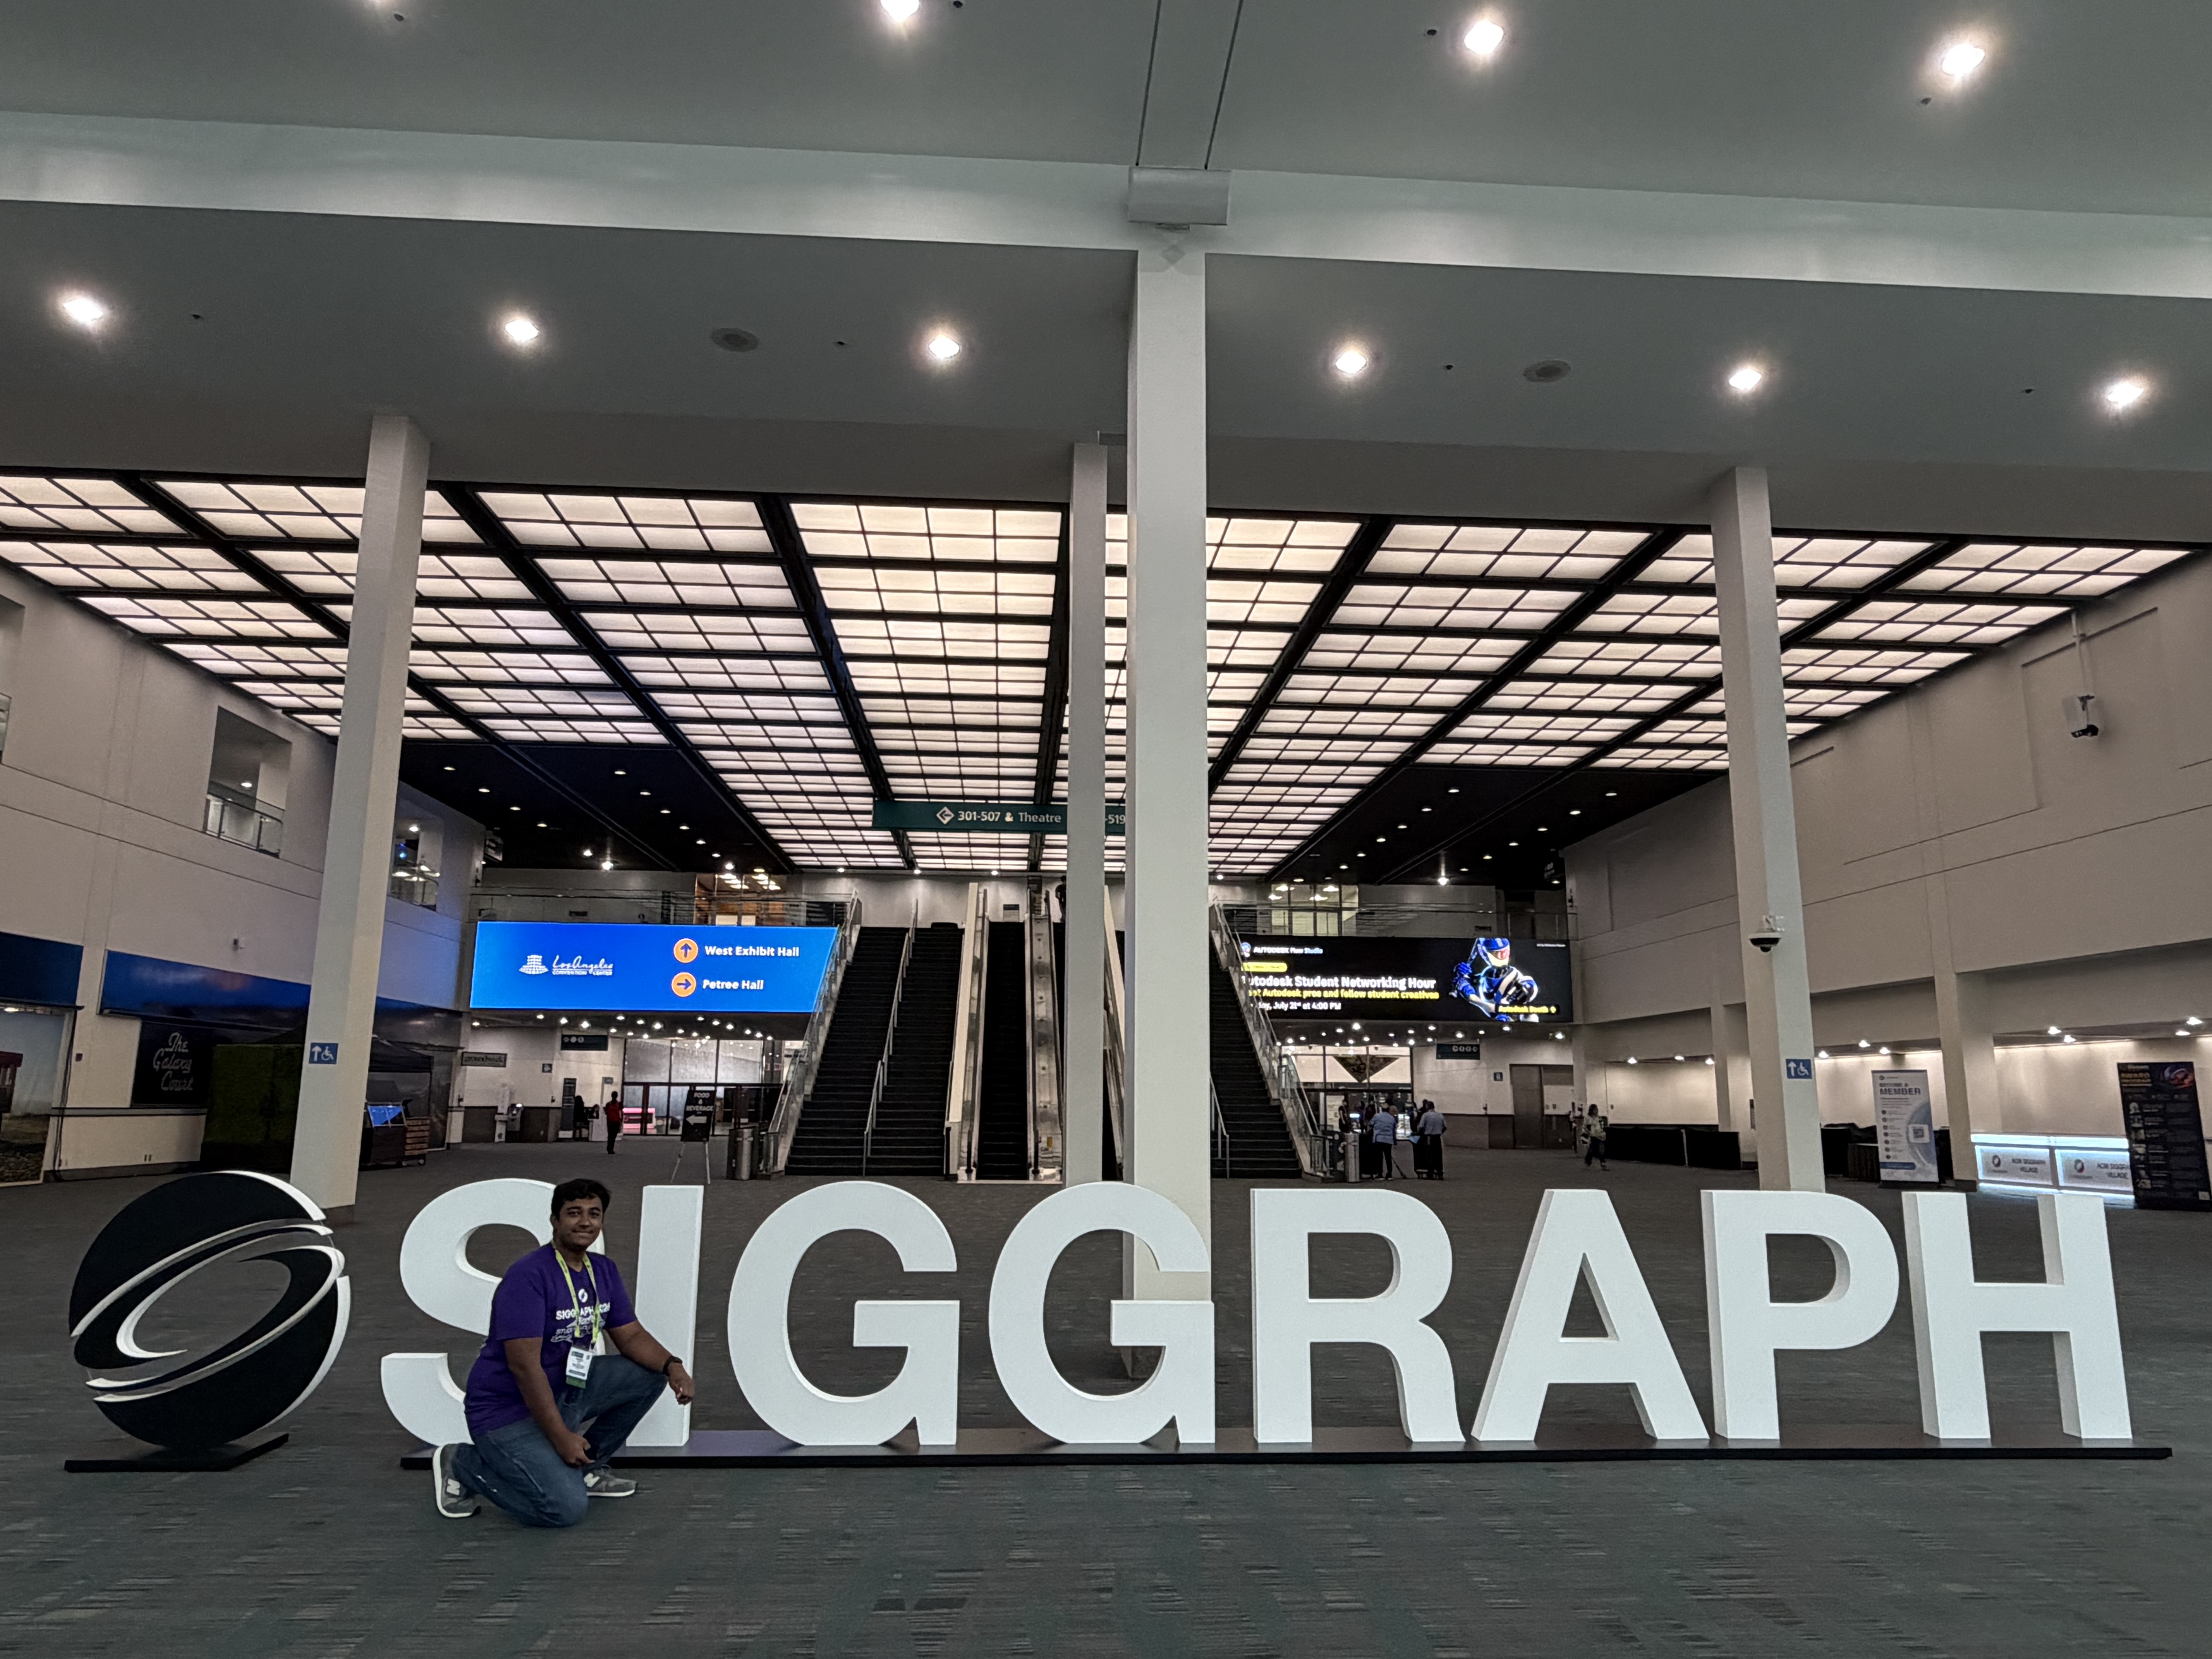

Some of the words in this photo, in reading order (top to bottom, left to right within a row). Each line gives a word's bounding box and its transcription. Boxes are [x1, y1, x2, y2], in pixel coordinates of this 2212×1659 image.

[958, 811, 1000, 821] 301-507
[1005, 812, 1013, 822] &
[1018, 812, 1061, 823] Theatre
[705, 946, 733, 955] West
[735, 946, 775, 956] Exhibit
[778, 947, 799, 957] Hall
[553, 955, 571, 968] Los
[573, 956, 613, 974] Angeles
[703, 979, 739, 989] Petree
[742, 980, 764, 989] Hall
[1295, 975, 1339, 987] Student
[1341, 976, 1406, 991] Networking
[1408, 977, 1436, 988] Hour
[1263, 989, 1302, 997] Autodesk
[1303, 990, 1321, 999] pros
[1323, 989, 1339, 998] and
[1340, 989, 1366, 998] fellow
[1367, 990, 1399, 998] student
[1401, 990, 1439, 999] creatives
[1273, 1001, 1289, 1011] July
[165, 1032, 189, 1052] The
[381, 1177, 2132, 1447] SIGGRAPH
[555, 1306, 594, 1320] SIGGAPH
